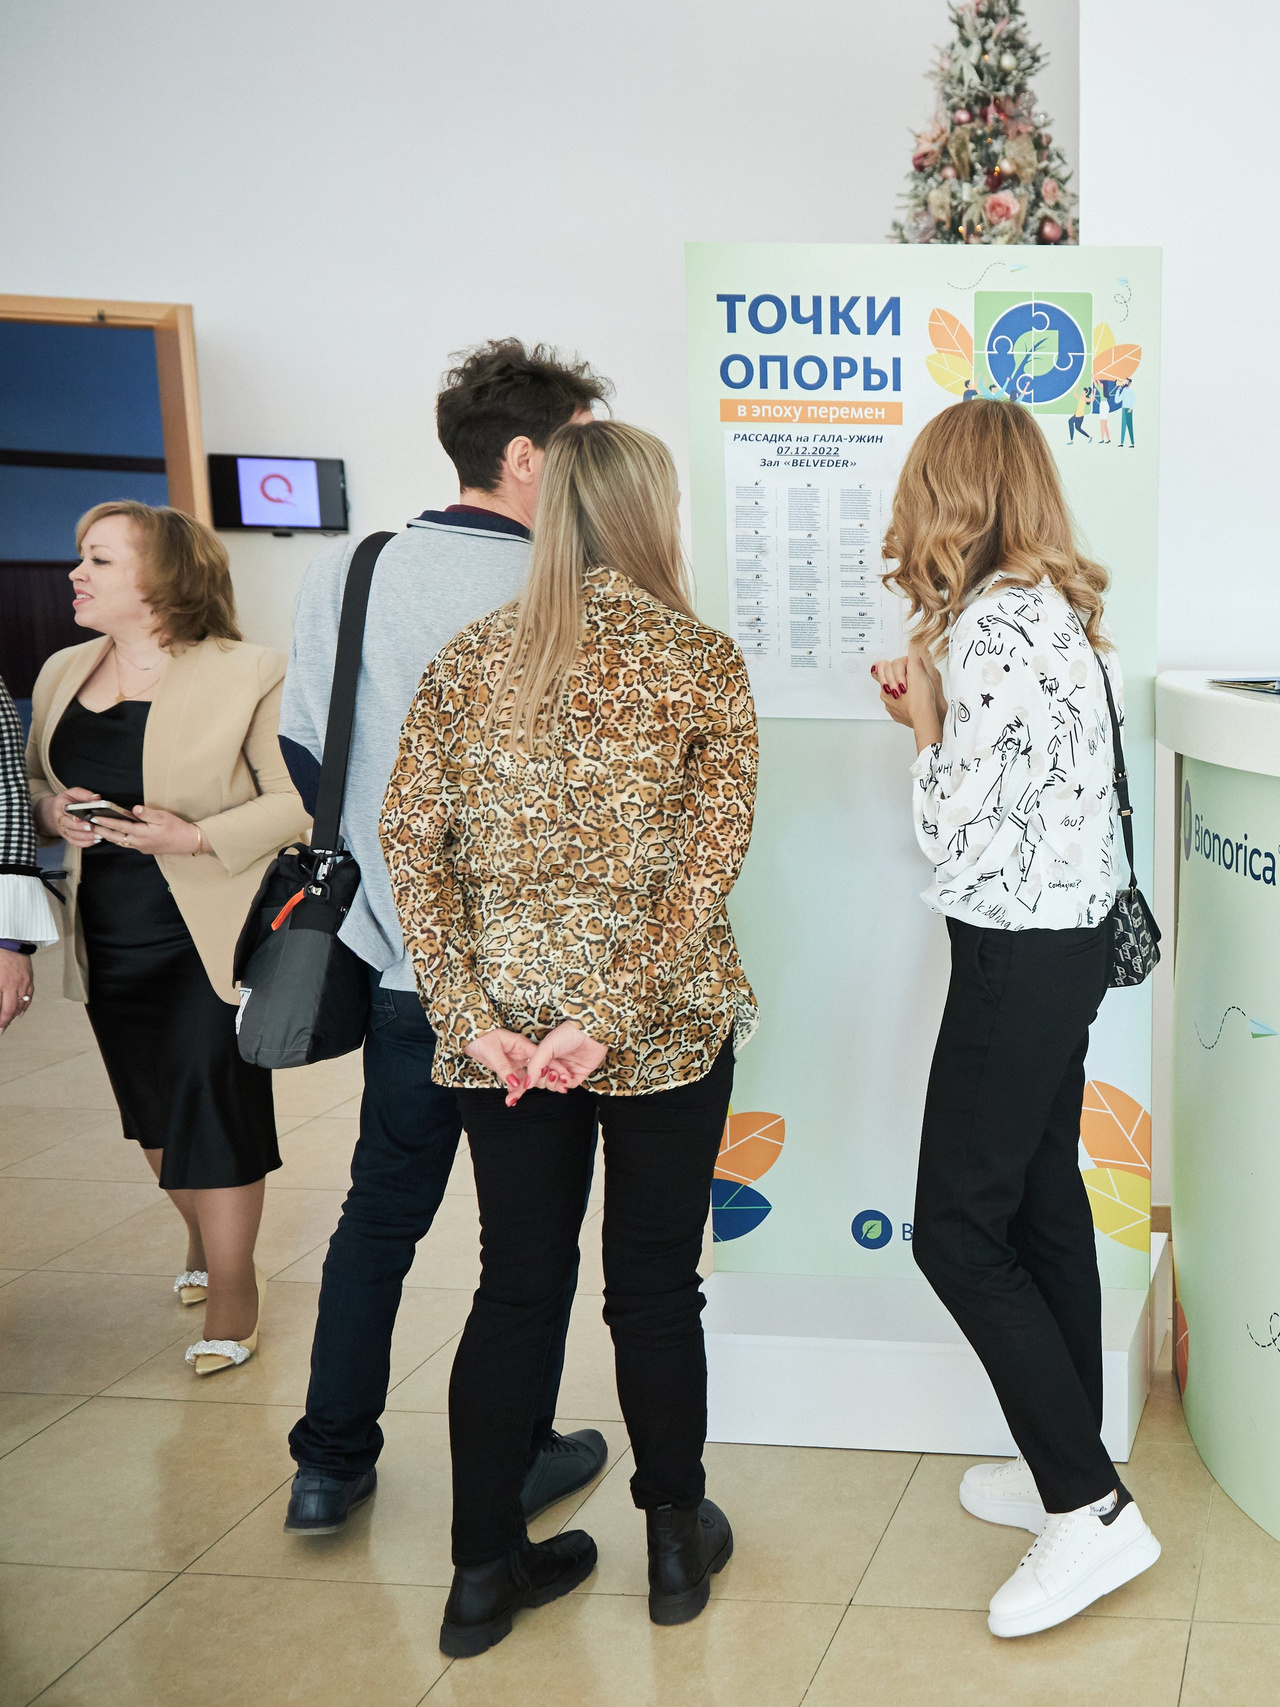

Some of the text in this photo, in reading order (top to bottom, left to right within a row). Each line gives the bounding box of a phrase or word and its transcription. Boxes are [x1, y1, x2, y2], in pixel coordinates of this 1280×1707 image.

[716, 293, 901, 336] ТОЧКИ
[719, 353, 902, 392] ОПОРЫ
[737, 404, 886, 423] в эпоху перемен
[733, 433, 884, 444] РАССАДКА на ГАЛА-УЖИН
[776, 446, 840, 456] 07.12.2022
[759, 458, 857, 468] Зал «BELVEDER»
